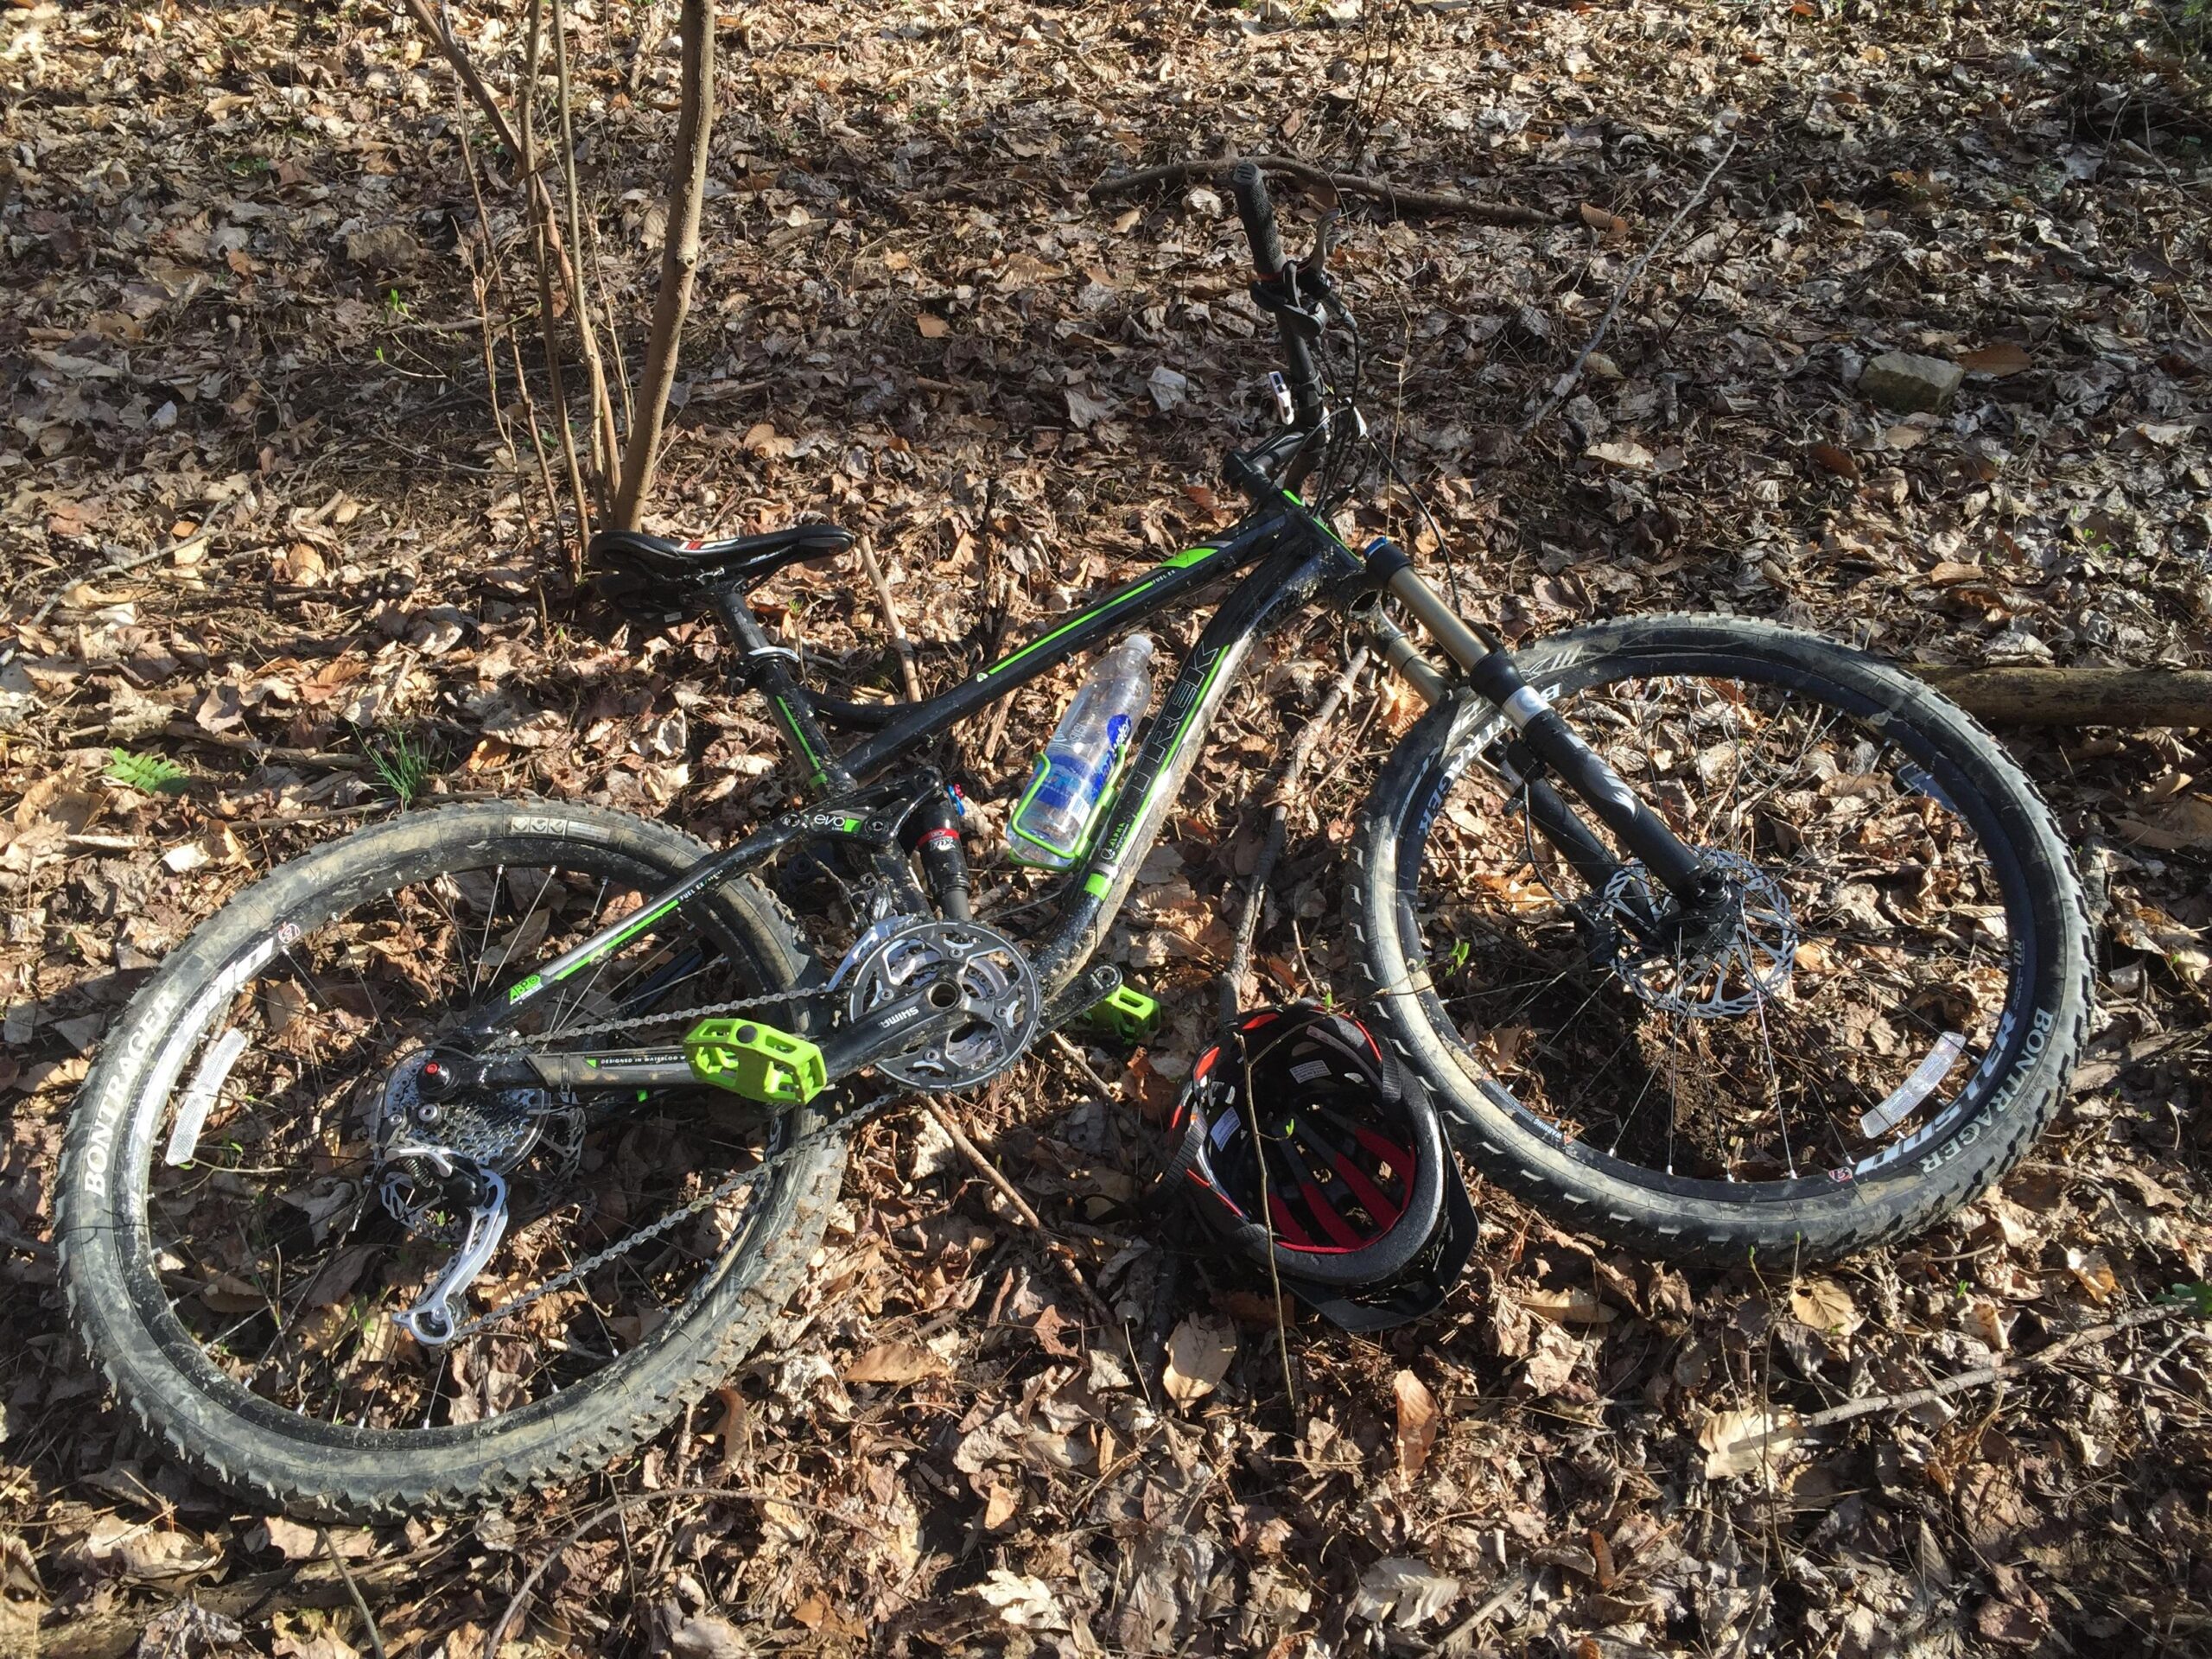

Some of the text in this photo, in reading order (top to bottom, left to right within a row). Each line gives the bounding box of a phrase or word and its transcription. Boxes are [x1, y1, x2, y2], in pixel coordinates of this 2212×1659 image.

[1122, 641, 1219, 800] TREK
[814, 814, 845, 827] evo
[84, 993, 179, 1198] BONTRAGER
[1533, 1118, 1563, 1140] WARNING
[1855, 1010, 2017, 1175] DUSTER
[1919, 1007, 2054, 1173] BONTRAGER
